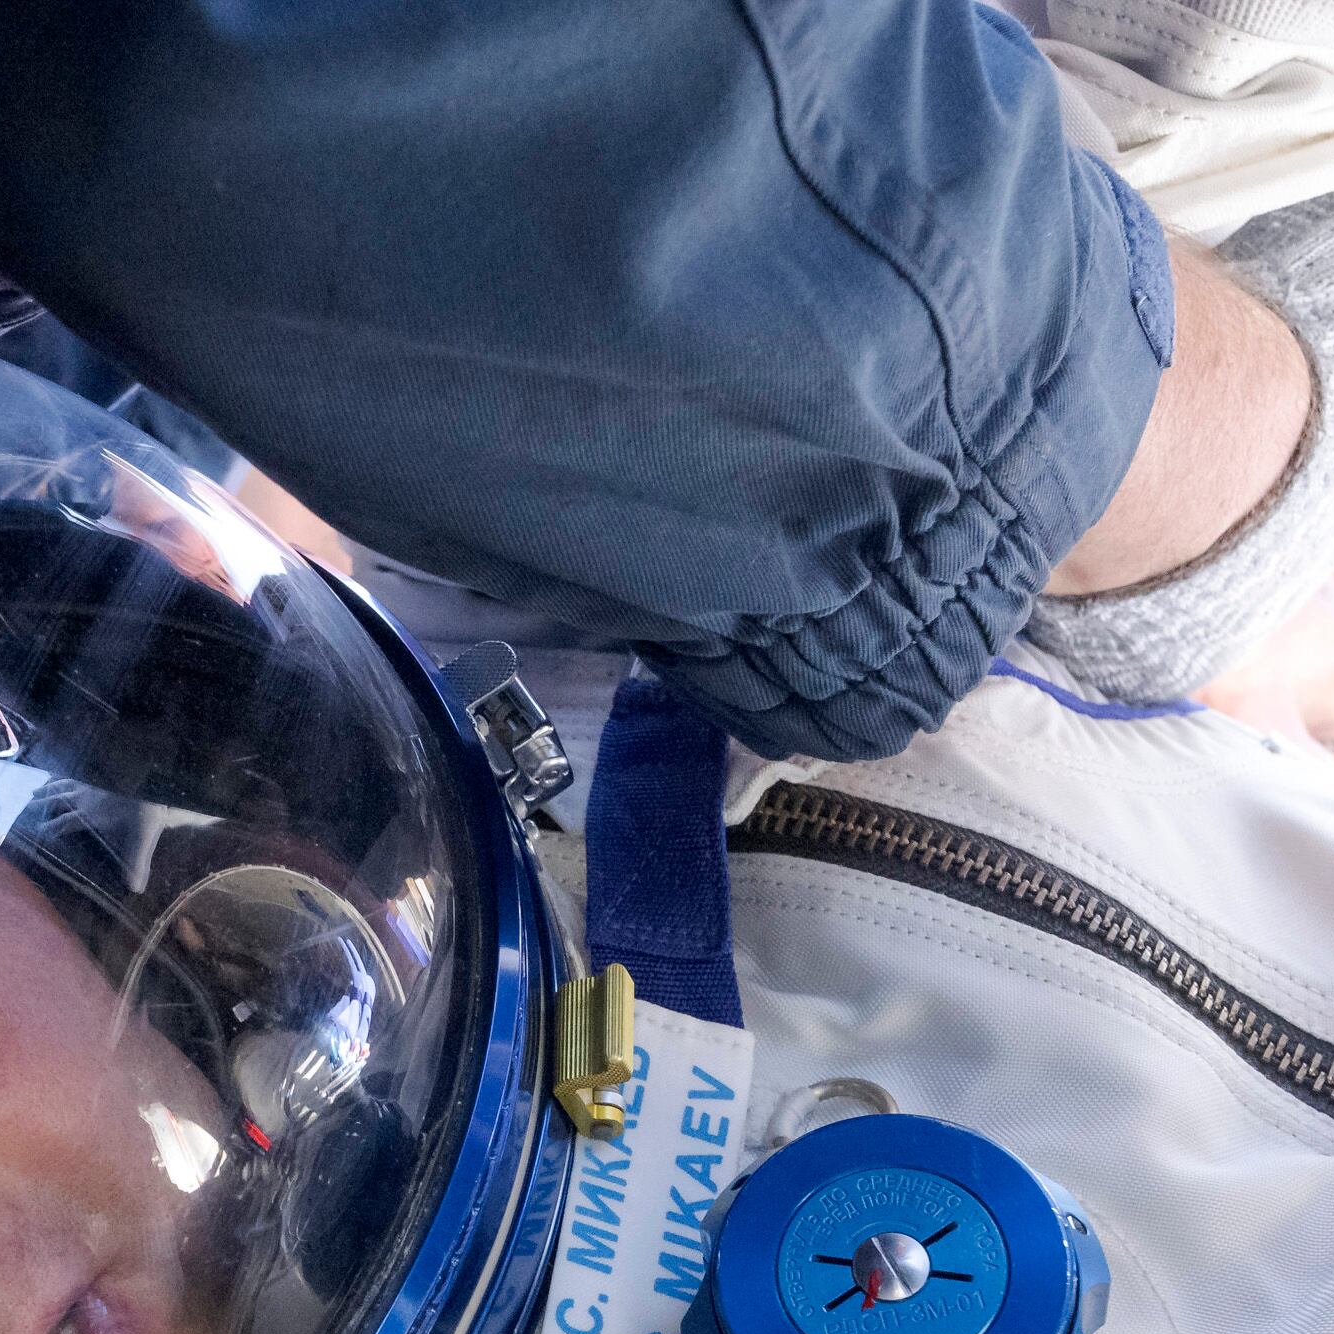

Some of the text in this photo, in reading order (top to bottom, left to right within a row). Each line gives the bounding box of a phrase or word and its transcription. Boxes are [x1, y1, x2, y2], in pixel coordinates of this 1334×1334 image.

[653, 1065, 735, 1304] MIKAEV
[819, 1187, 847, 1212] ДО
[856, 1174, 962, 1209] СРЕДНЕГО
[964, 1211, 1000, 1272] ПОРА
